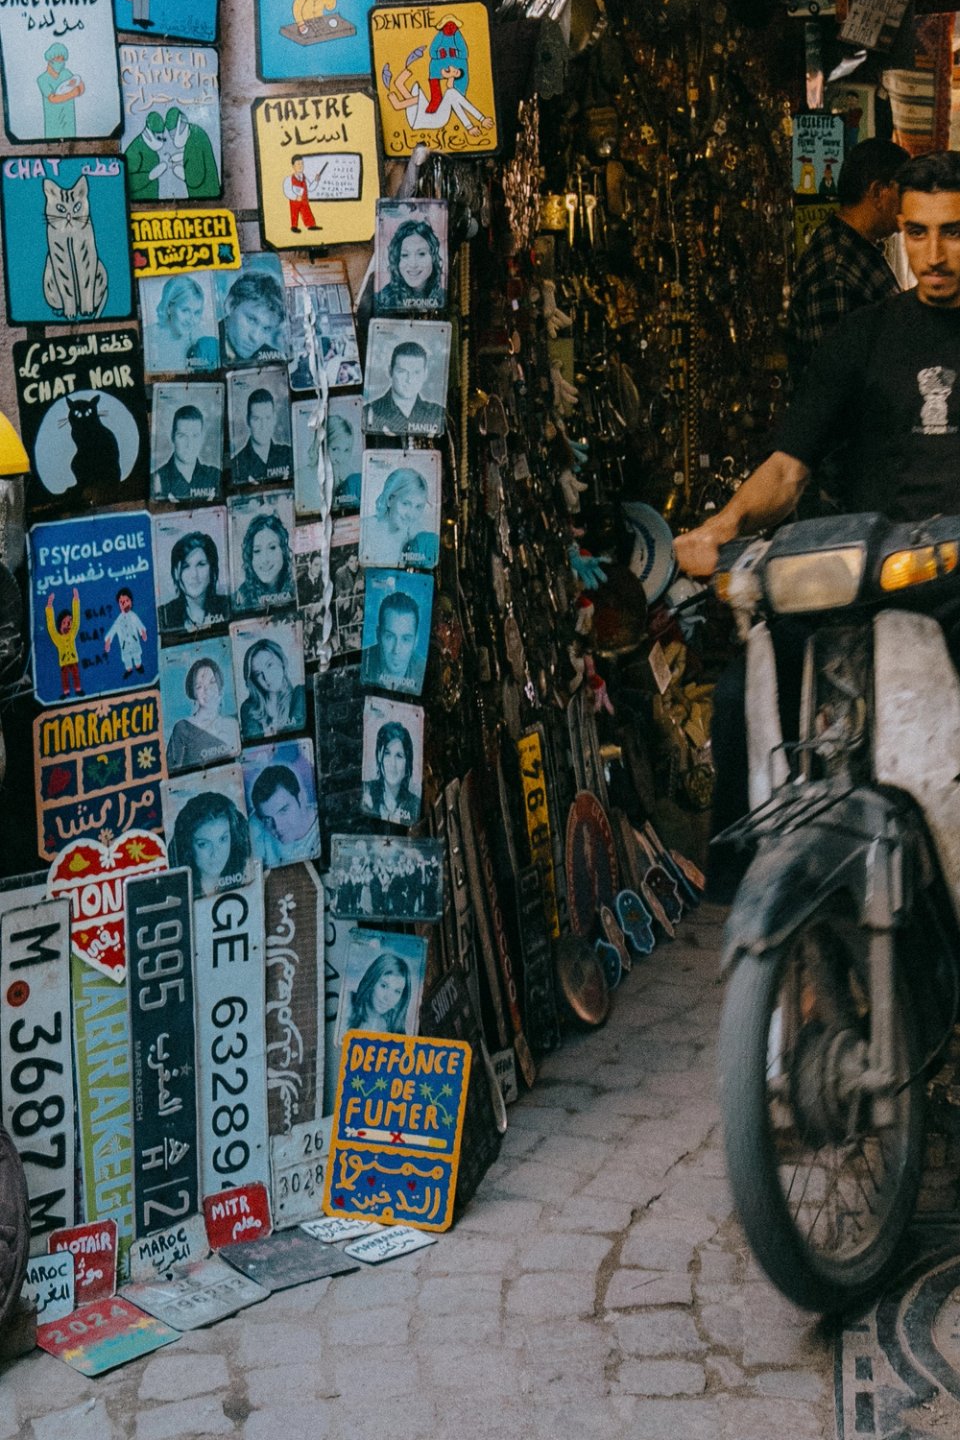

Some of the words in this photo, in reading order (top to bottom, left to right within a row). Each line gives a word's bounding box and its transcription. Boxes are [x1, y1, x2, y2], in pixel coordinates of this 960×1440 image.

[264, 95, 354, 123] MAITRE
[4, 158, 62, 179] CHAT
[23, 373, 77, 405] CHAT
[89, 364, 135, 391] NOIR
[38, 530, 147, 567] PSYCOLOGUE
[42, 702, 156, 757] MARRAKECH
[9, 921, 62, 971] M
[210, 891, 250, 970] GE
[135, 895, 186, 1012] 1995
[147, 1032, 183, 1117] المغرب
[349, 1044, 460, 1076] DEFFONCE
[9, 1011, 67, 1167] 3687
[72, 960, 134, 1238] ARRAKECH
[210, 995, 250, 1191] 63289
[389, 1077, 416, 1102] DE
[343, 1102, 440, 1130] FUMER
[138, 1227, 189, 1260] MAROC
[45, 1303, 132, 1346] 2024
